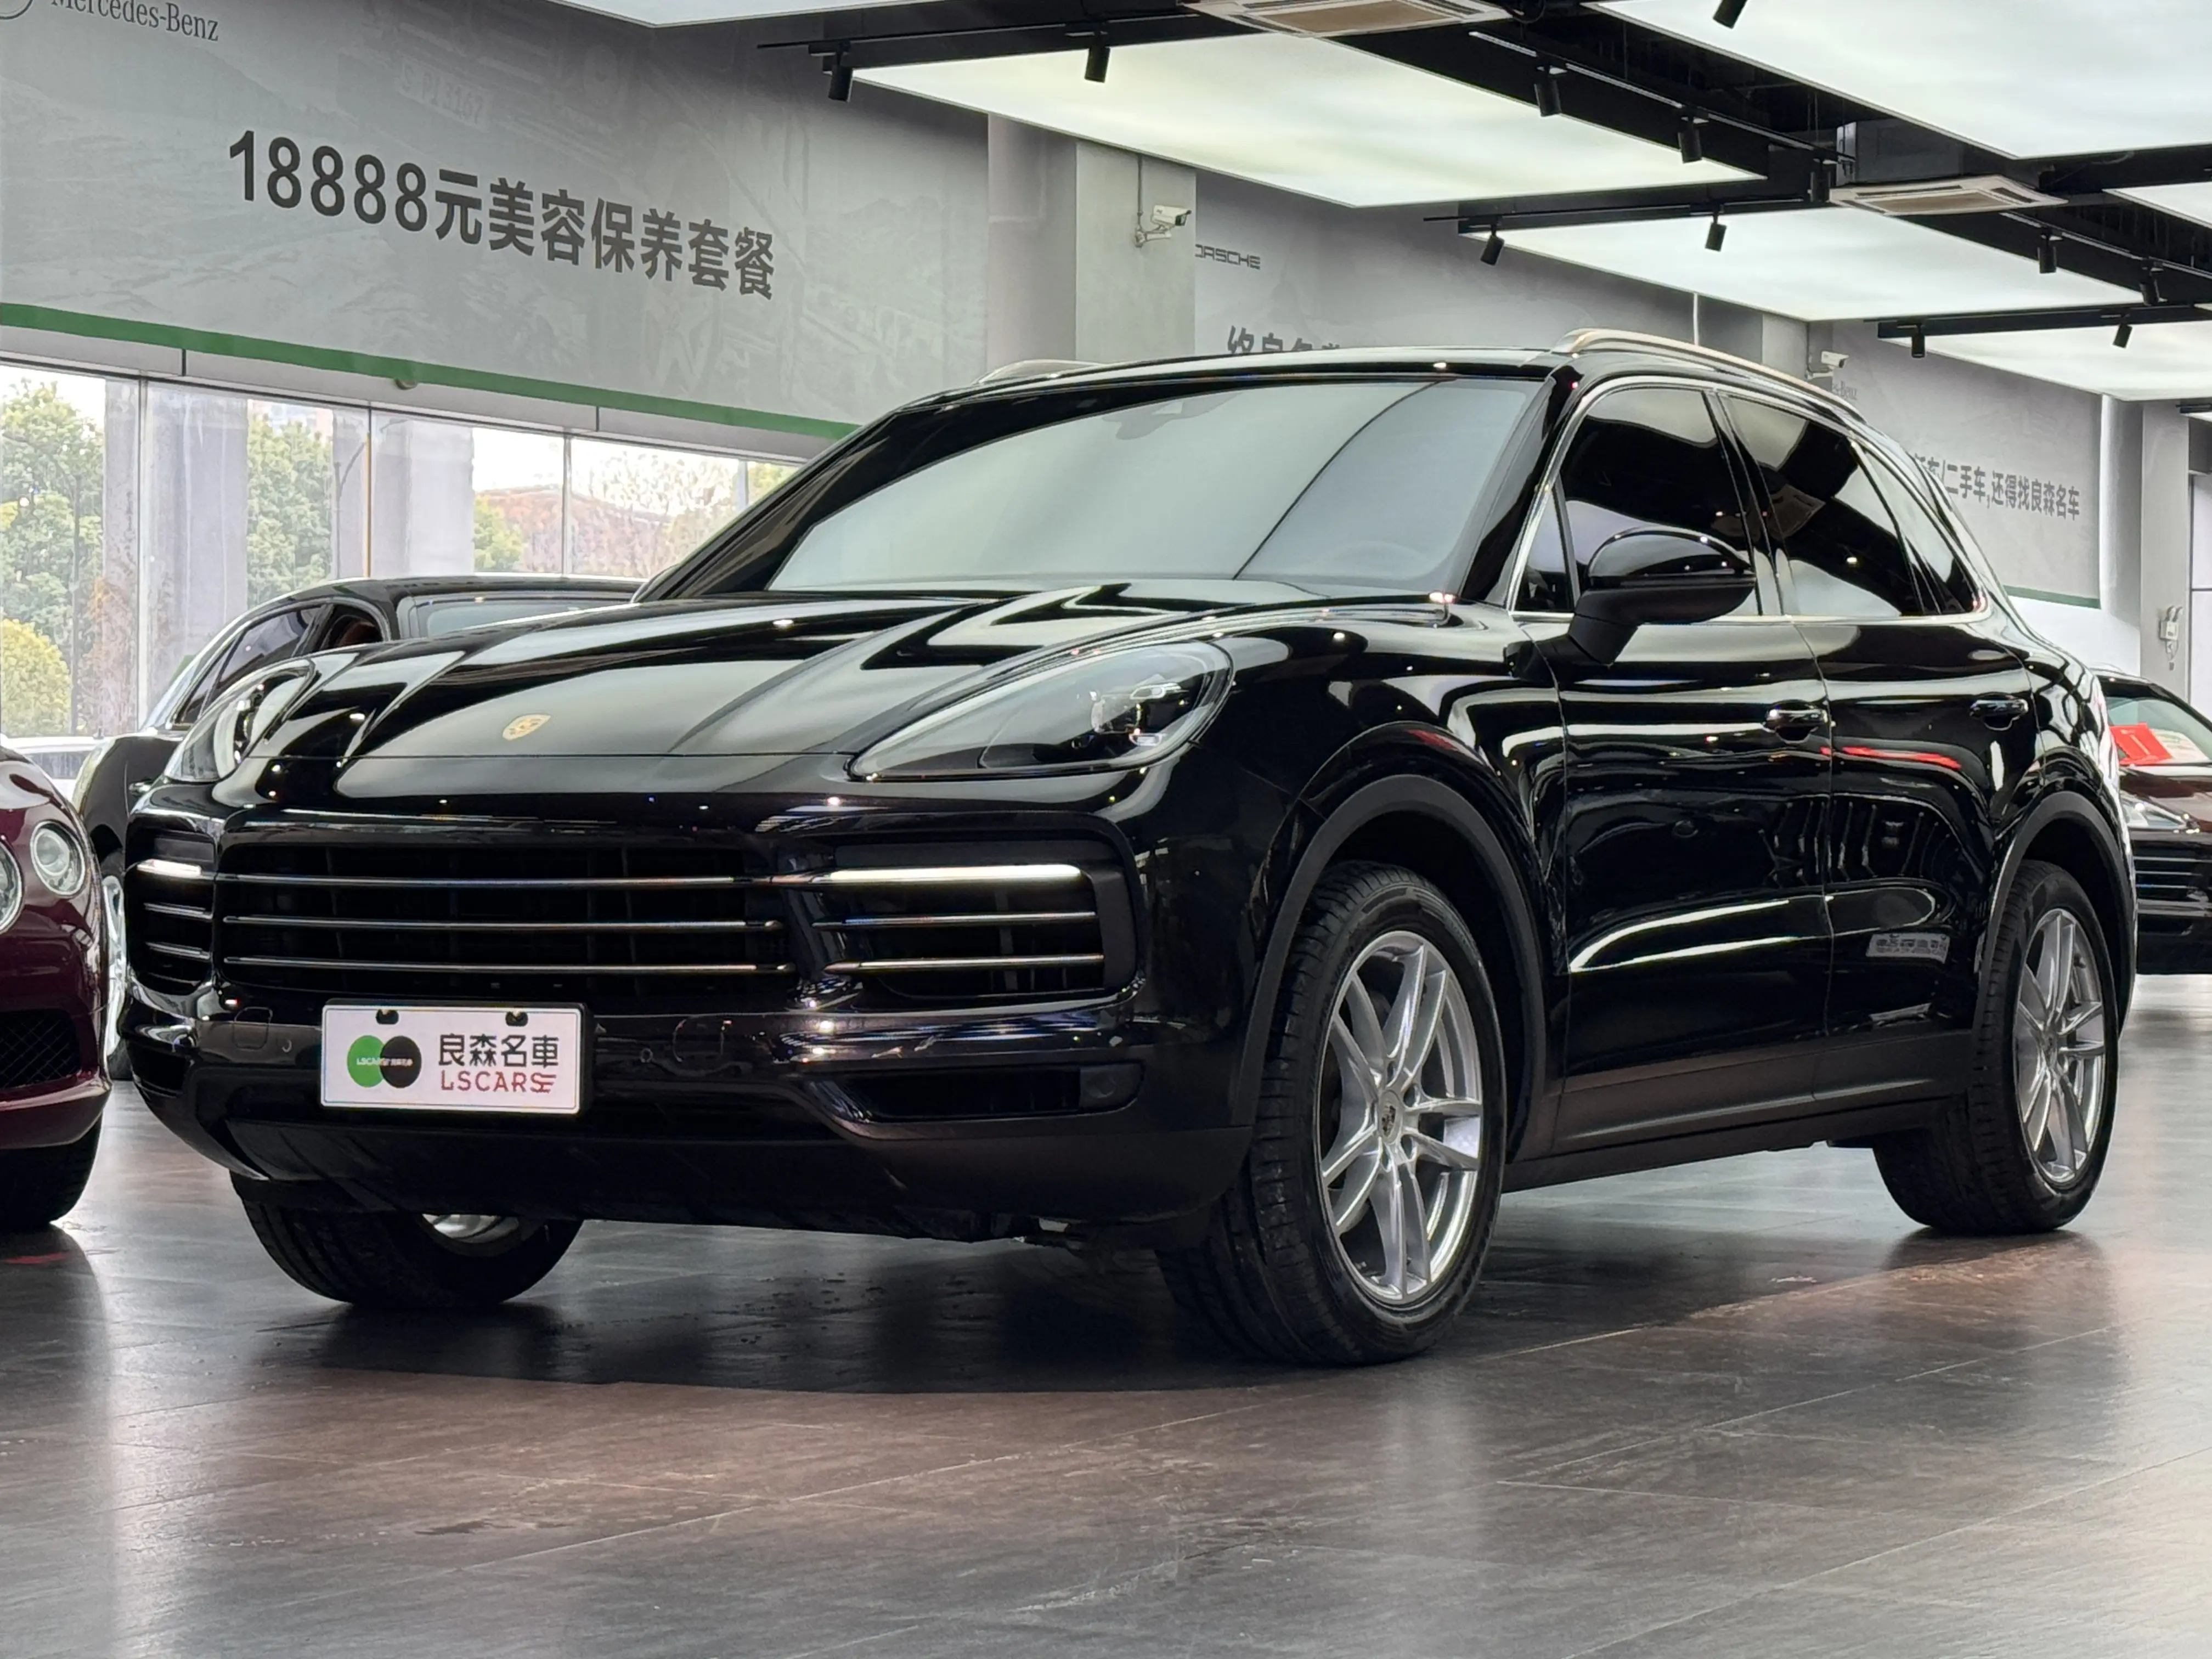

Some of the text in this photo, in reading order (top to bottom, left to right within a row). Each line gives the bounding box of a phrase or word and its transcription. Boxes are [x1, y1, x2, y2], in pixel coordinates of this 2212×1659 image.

[51, 0, 219, 41] ercedes-Benz
[229, 129, 775, 300] 18888元美容保养套餐
[439, 1033, 559, 1068] 良森名車
[441, 1070, 557, 1093] LSCARS
